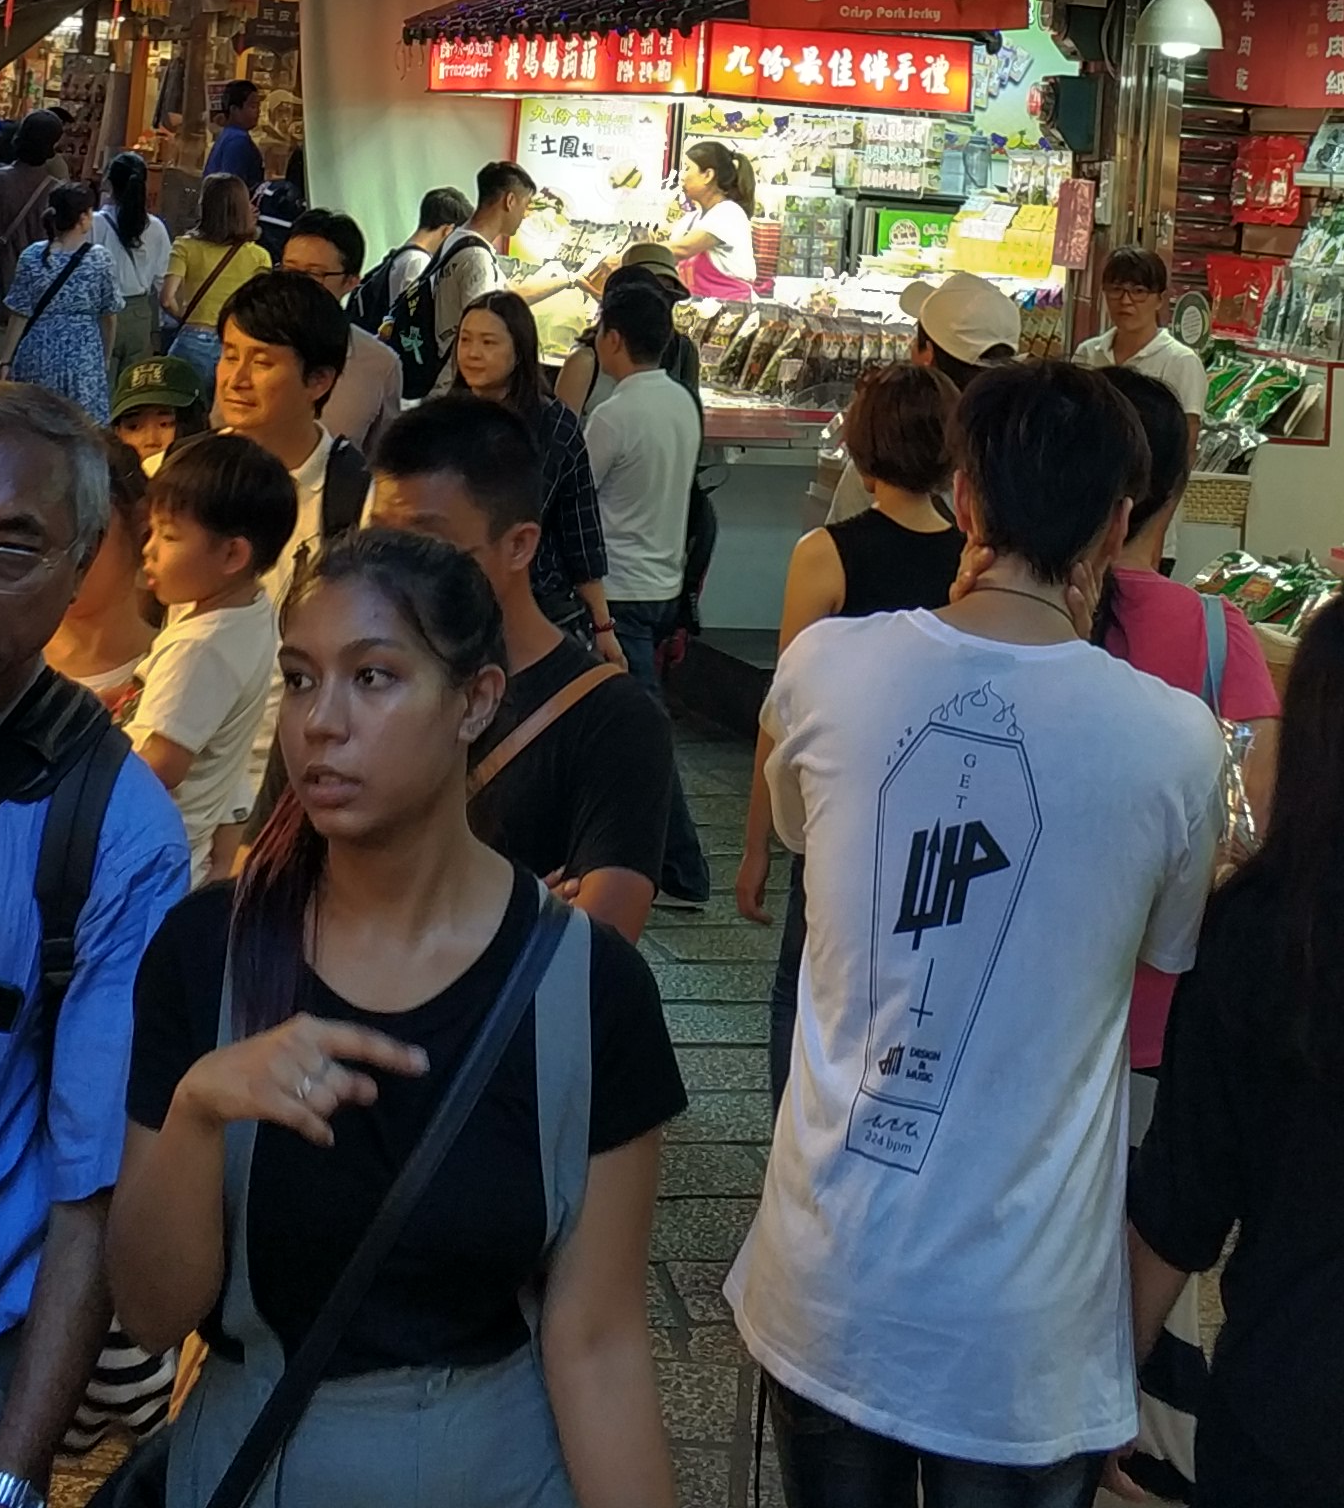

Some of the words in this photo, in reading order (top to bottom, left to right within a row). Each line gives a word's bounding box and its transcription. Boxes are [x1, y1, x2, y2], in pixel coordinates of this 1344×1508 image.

[839, 5, 873, 21] Crisp
[876, 6, 906, 20] Pork
[908, 7, 942, 23] Jerky
[1235, 0, 1256, 92] 牛肉乾
[723, 44, 951, 95] 九份最佳伴手禮
[955, 752, 977, 810] GET
[892, 818, 1011, 951] UP
[909, 1046, 942, 1062] DESIGN
[905, 1068, 934, 1084] MUSIC
[886, 1137, 912, 1154] bpm
